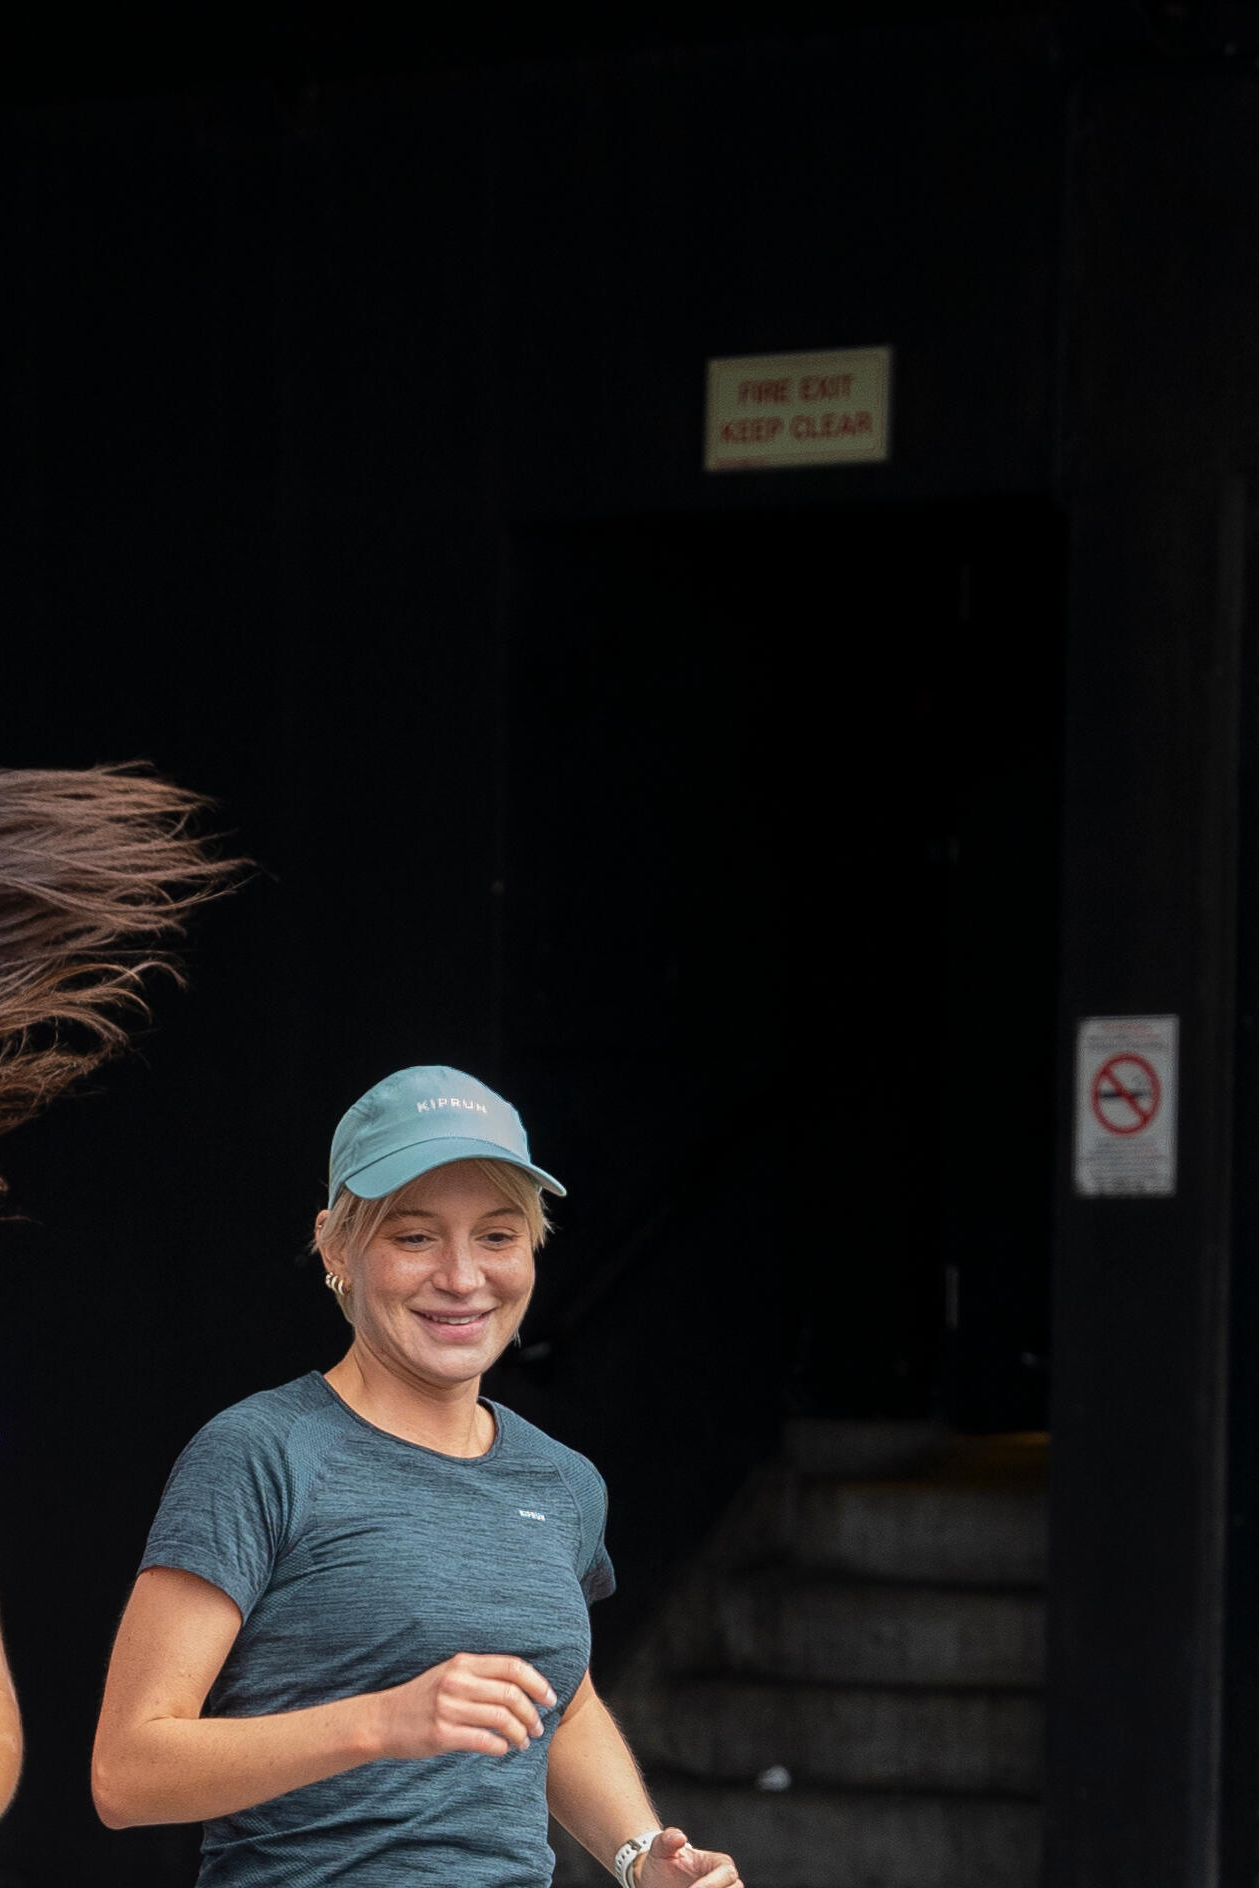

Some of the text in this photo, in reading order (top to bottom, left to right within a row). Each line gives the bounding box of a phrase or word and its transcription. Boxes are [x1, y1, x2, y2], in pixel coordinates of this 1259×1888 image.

[738, 373, 854, 405] FIRE EXIT
[720, 411, 873, 444] KEEP CLEAR
[417, 1097, 487, 1114] KIPRUN
